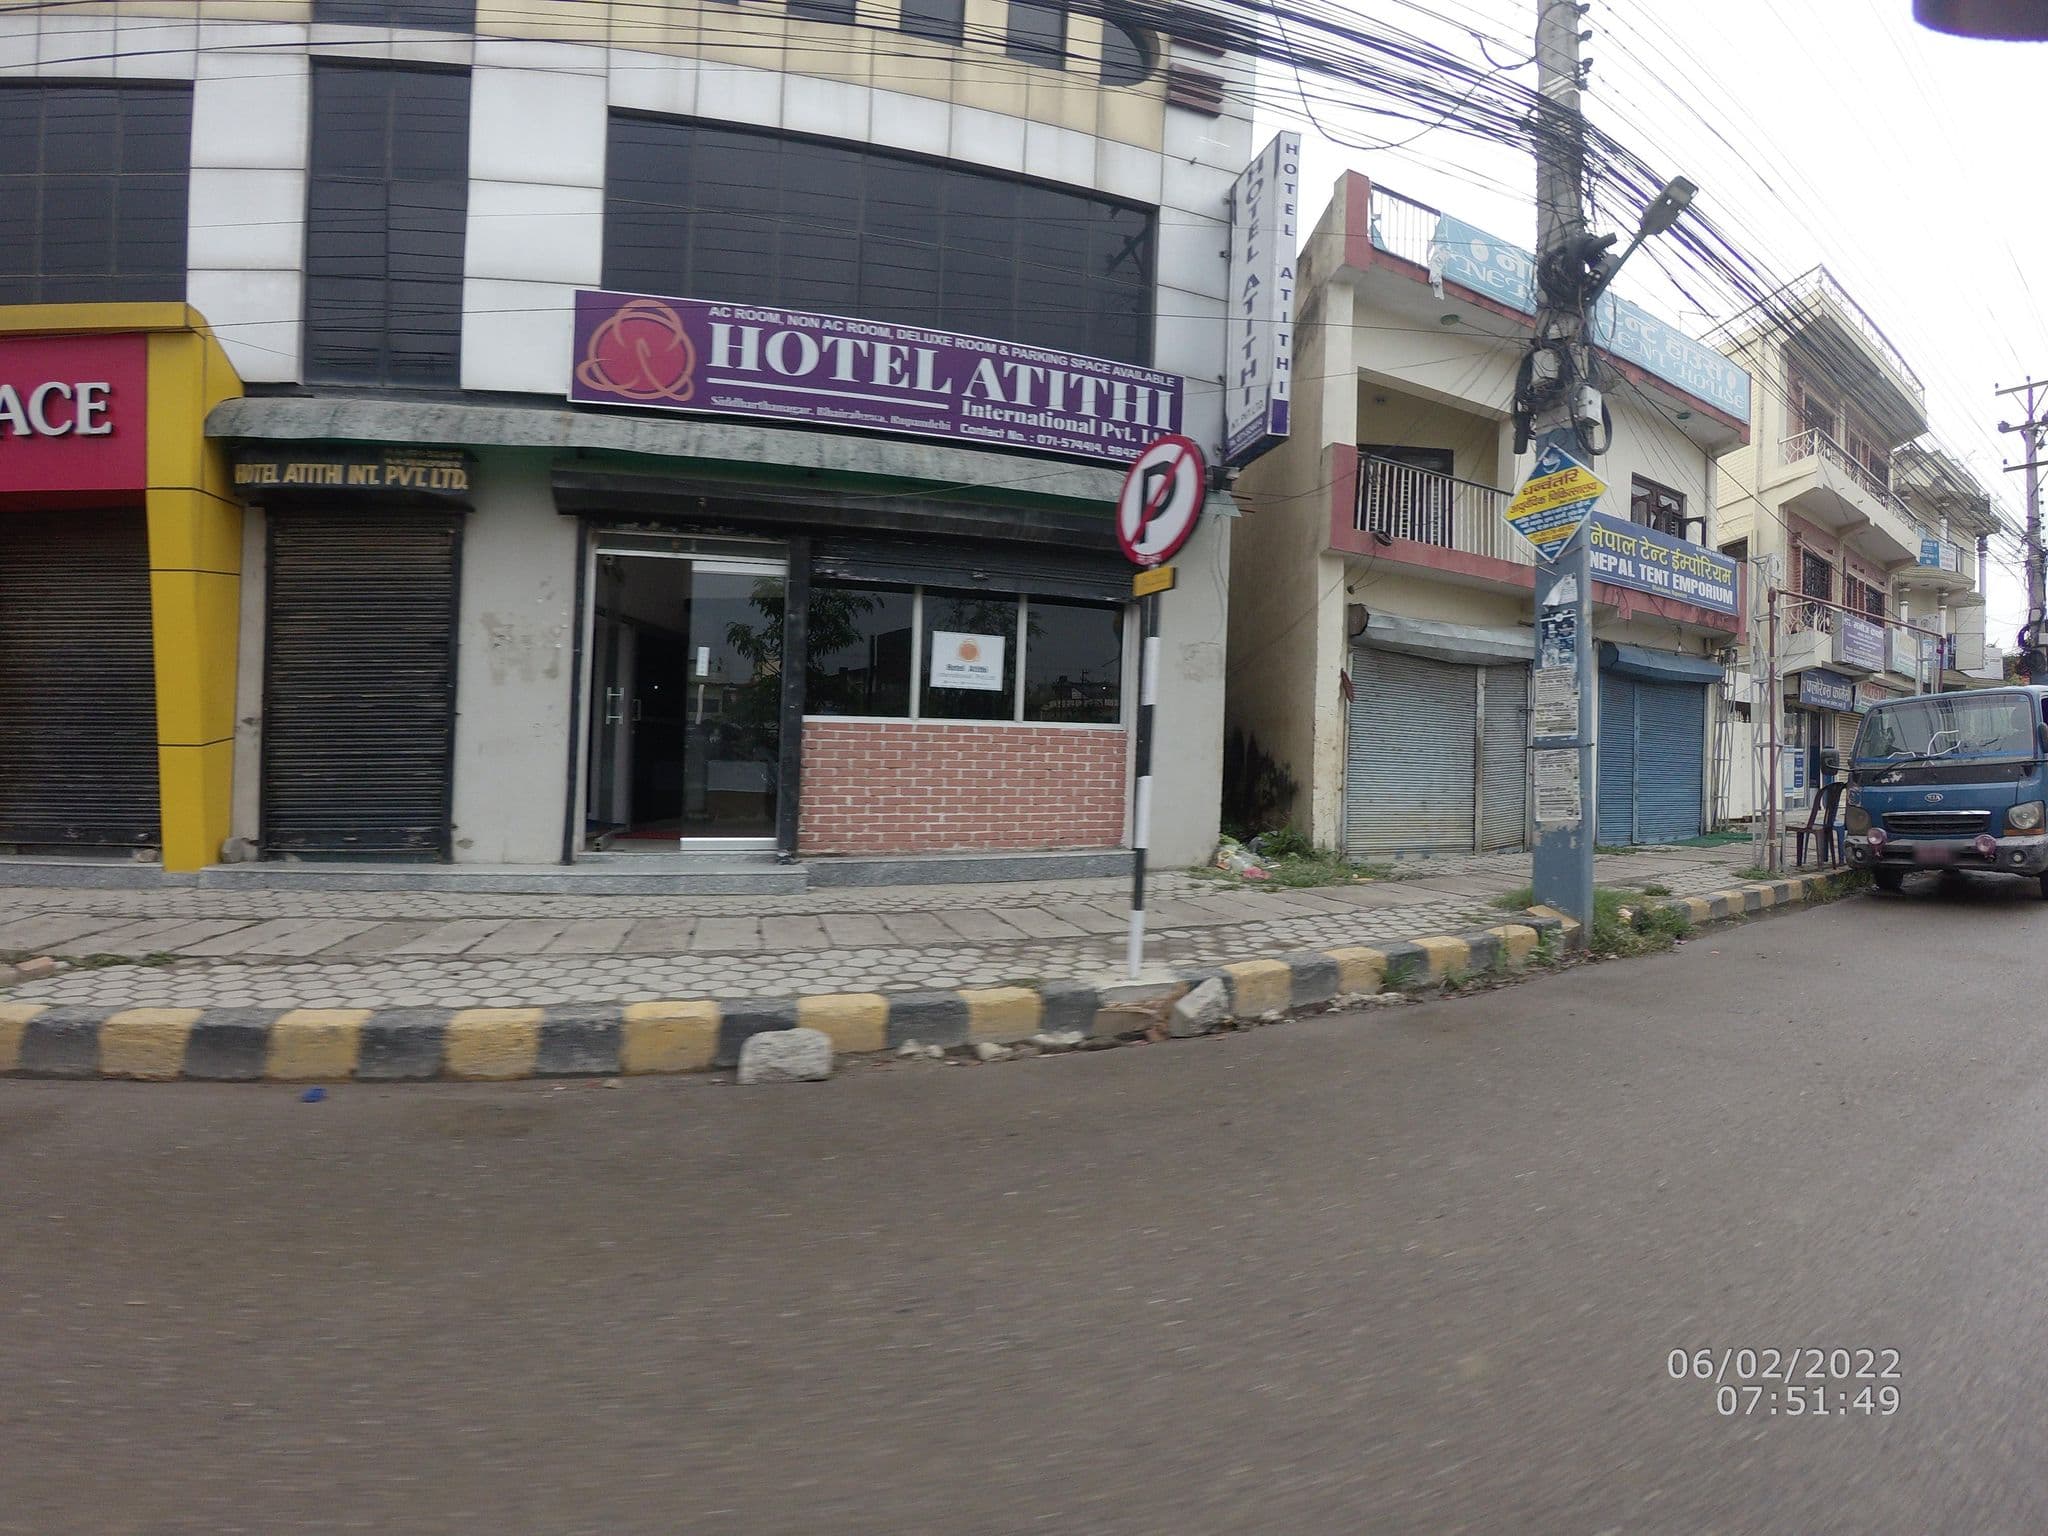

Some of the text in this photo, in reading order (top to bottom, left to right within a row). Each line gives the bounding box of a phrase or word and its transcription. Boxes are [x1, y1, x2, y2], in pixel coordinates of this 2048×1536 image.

[1246, 157, 1263, 264] HOTEL
[1277, 143, 1298, 394] HOTEL ATITHI
[708, 306, 732, 318] AC
[787, 315, 820, 328] NON
[822, 320, 843, 331] AC
[897, 329, 952, 347] DELUXE
[955, 338, 997, 354] ROOM
[999, 345, 1009, 356] &
[1011, 347, 1069, 366] PARKING
[1070, 357, 1111, 374] SPACE
[1112, 365, 1175, 387] AVAILABLE
[1240, 274, 1260, 406] ATITHI
[706, 322, 952, 394] HOTEL
[961, 357, 1174, 430] ATITHI
[0, 381, 113, 436] ACE
[960, 423, 1005, 438] Contact
[961, 400, 1095, 435] International
[1100, 421, 1137, 443] Pvt.
[283, 463, 343, 484] ATITHI
[1589, 521, 1638, 557] नेपाल
[1639, 536, 1670, 566] टेन्ट
[1589, 550, 1636, 579] NEPAL
[1638, 563, 1670, 587] TENT
[1672, 570, 1734, 605] EMPORIUM
